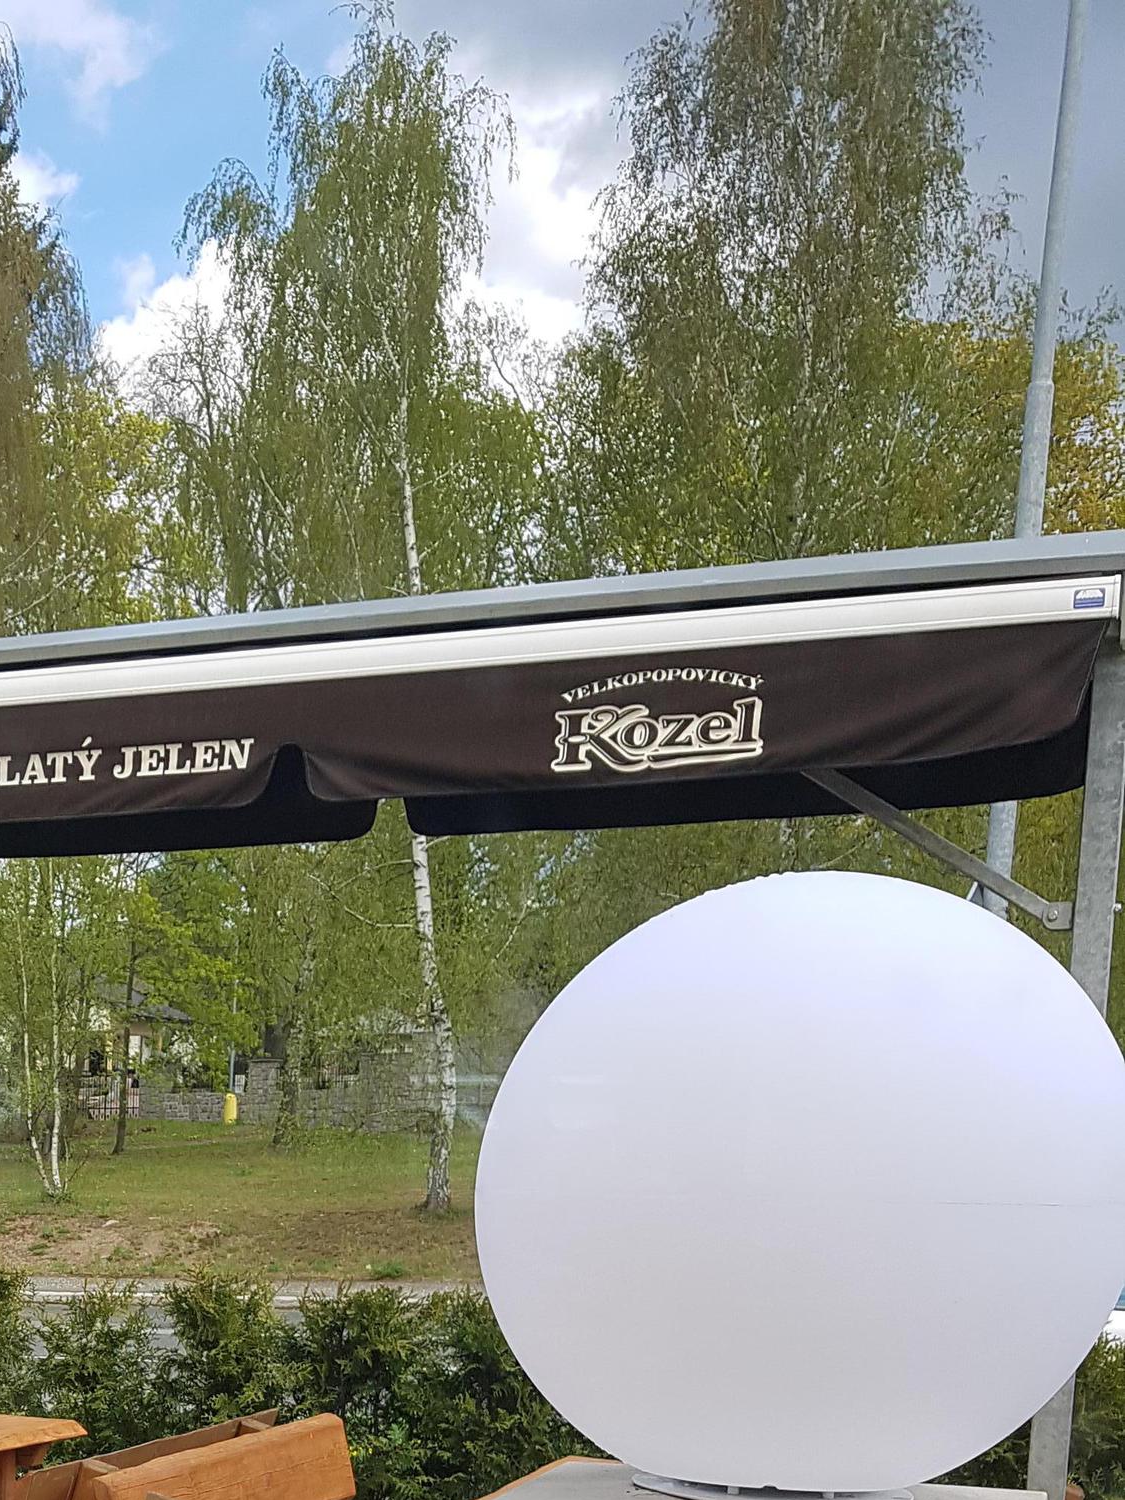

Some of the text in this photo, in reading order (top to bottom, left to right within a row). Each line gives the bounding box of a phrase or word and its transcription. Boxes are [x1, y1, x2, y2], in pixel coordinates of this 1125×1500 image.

[561, 667, 764, 703] VELKOPOPOVICKÝ
[551, 696, 764, 772] Kozel
[113, 738, 254, 779] JELEN
